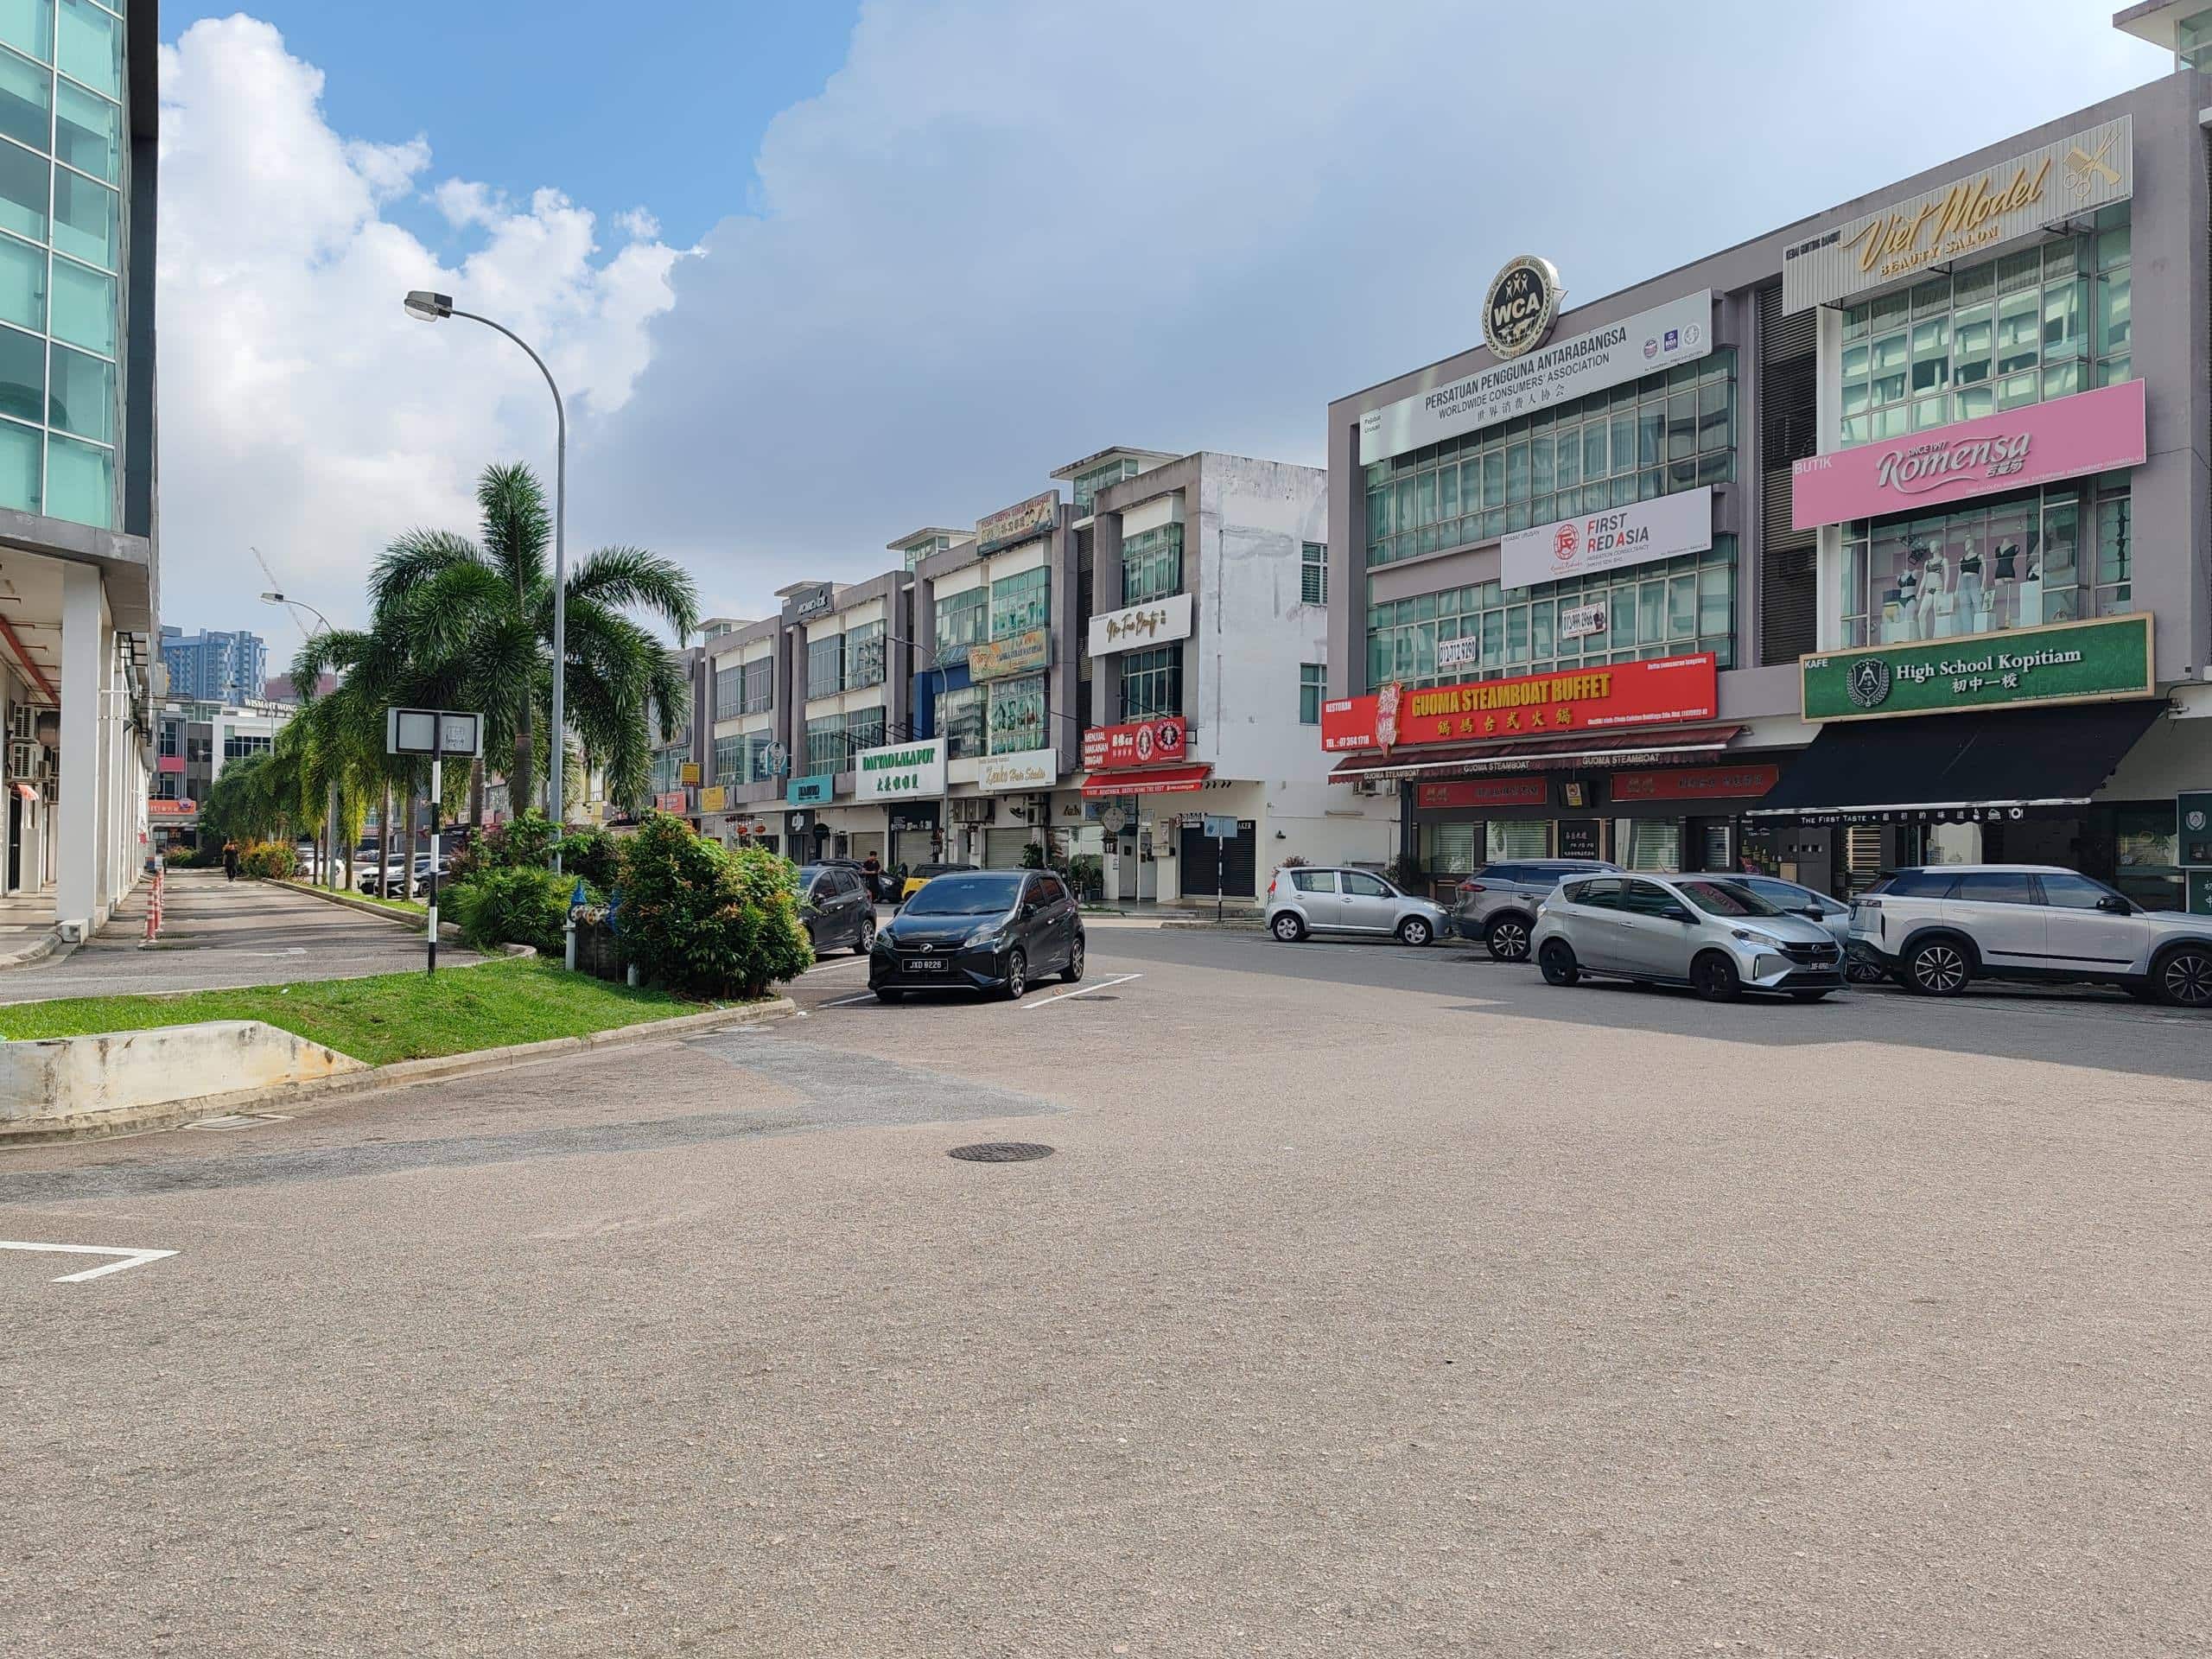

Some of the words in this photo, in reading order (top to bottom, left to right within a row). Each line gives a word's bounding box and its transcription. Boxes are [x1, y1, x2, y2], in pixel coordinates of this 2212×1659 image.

[1837, 201, 1944, 272] Viet
[1934, 158, 2050, 244] Model
[1880, 247, 1941, 276] BEAUTY
[1945, 226, 1999, 254] SALON
[1494, 292, 1540, 327] WCA
[1426, 379, 1478, 410] PERSATUAN
[1481, 359, 1535, 391] PENGGUNA
[1537, 327, 1627, 371] ANTARABANGSA
[1439, 393, 1487, 419] WORLDWIDE
[1547, 353, 1610, 382] ASSOCIATION
[1908, 444, 1930, 457] SINCE
[1930, 441, 1948, 453] 1997
[1794, 456, 1833, 474] BUTIK
[1876, 432, 2032, 493] Romensa
[1587, 512, 1628, 535] FIRST
[1805, 658, 1828, 670] KAFE
[1897, 663, 1936, 683] High
[1940, 655, 1993, 676] School
[1998, 649, 2082, 673] Kopitiam
[1412, 691, 1460, 717] GUOMA
[1461, 680, 1549, 712] STEAMBOAT
[1550, 672, 1612, 702] BUFFET
[1952, 673, 2019, 694] 初中一校
[1325, 701, 1352, 713] RESTORAN
[1464, 765, 1488, 773] GUOMA
[1489, 760, 1531, 772] STEAMBOAT
[1581, 755, 1611, 766] GUOMA
[1611, 753, 1661, 764] STEAMBOAT
[1363, 771, 1385, 780] GUOMA
[1385, 768, 1420, 779] STEAMBOAT
[1818, 815, 1840, 824] FIRST
[1841, 814, 1867, 823] TASTE
